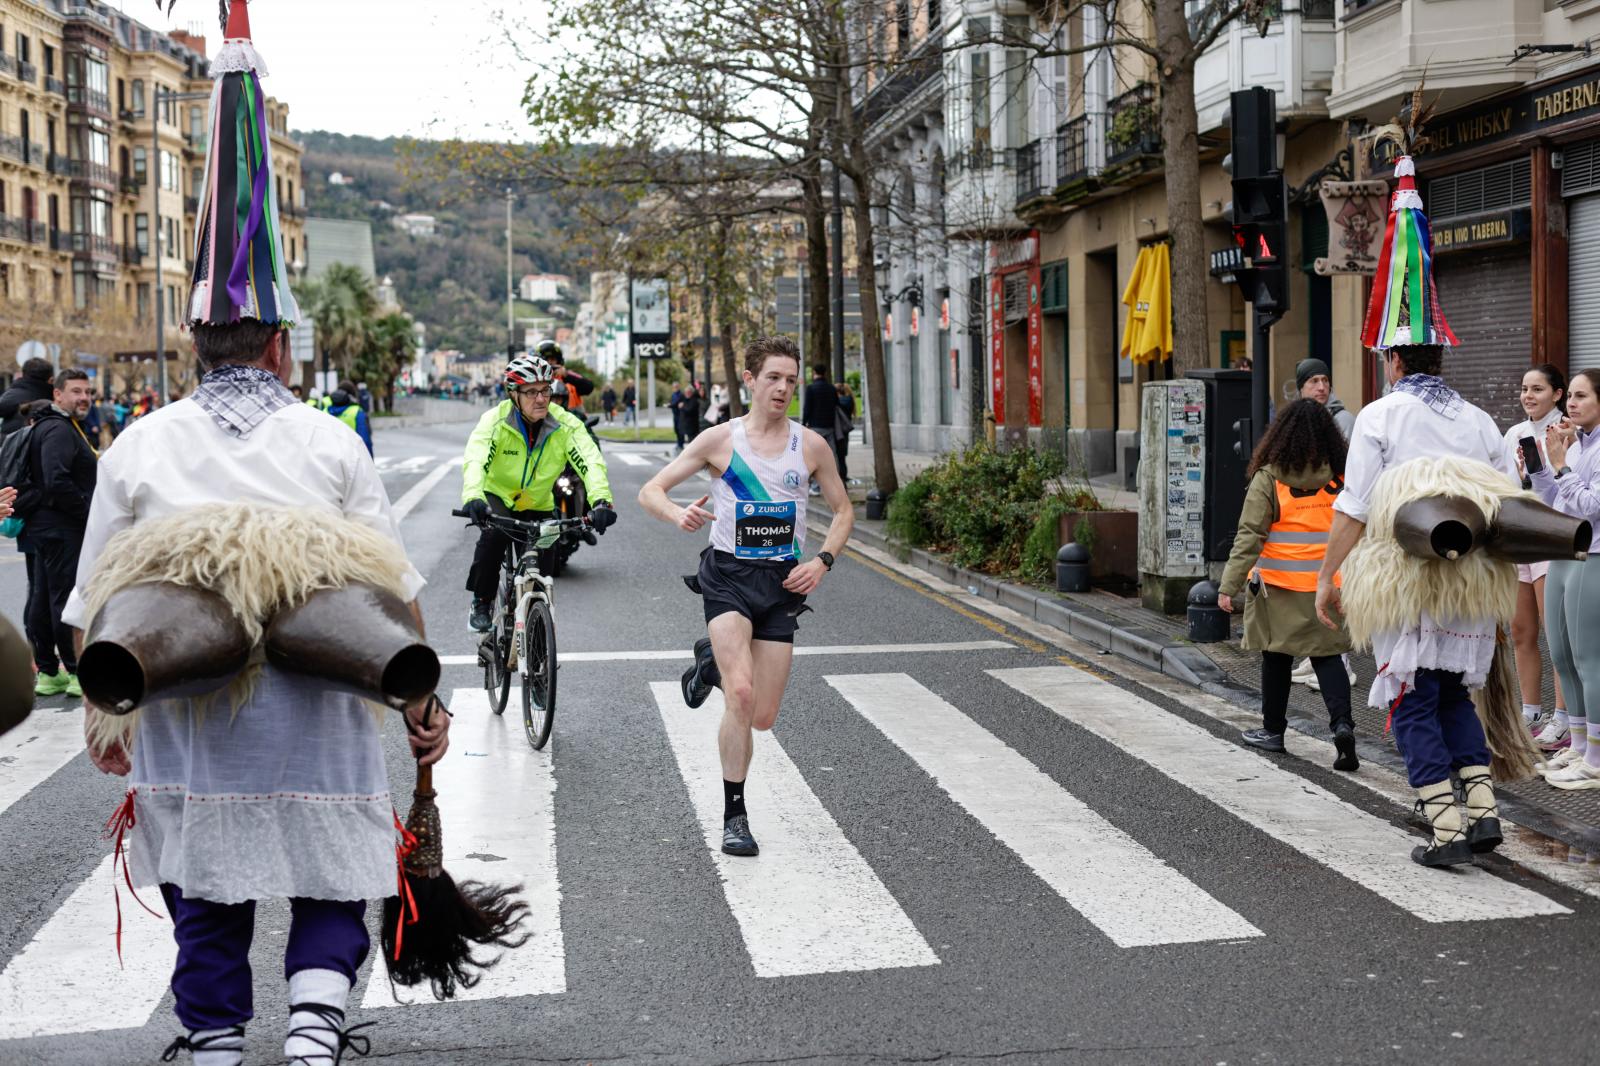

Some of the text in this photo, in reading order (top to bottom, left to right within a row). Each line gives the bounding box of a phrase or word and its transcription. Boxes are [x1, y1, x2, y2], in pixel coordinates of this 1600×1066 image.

[1457, 107, 1513, 144] WHISKY
[1444, 229, 1453, 245] EN
[1455, 226, 1469, 243] VIVO
[1471, 219, 1507, 240] TABERNA
[758, 505, 788, 513] ZURICH
[745, 525, 791, 536] THOMAS
[762, 539, 773, 547] 26
